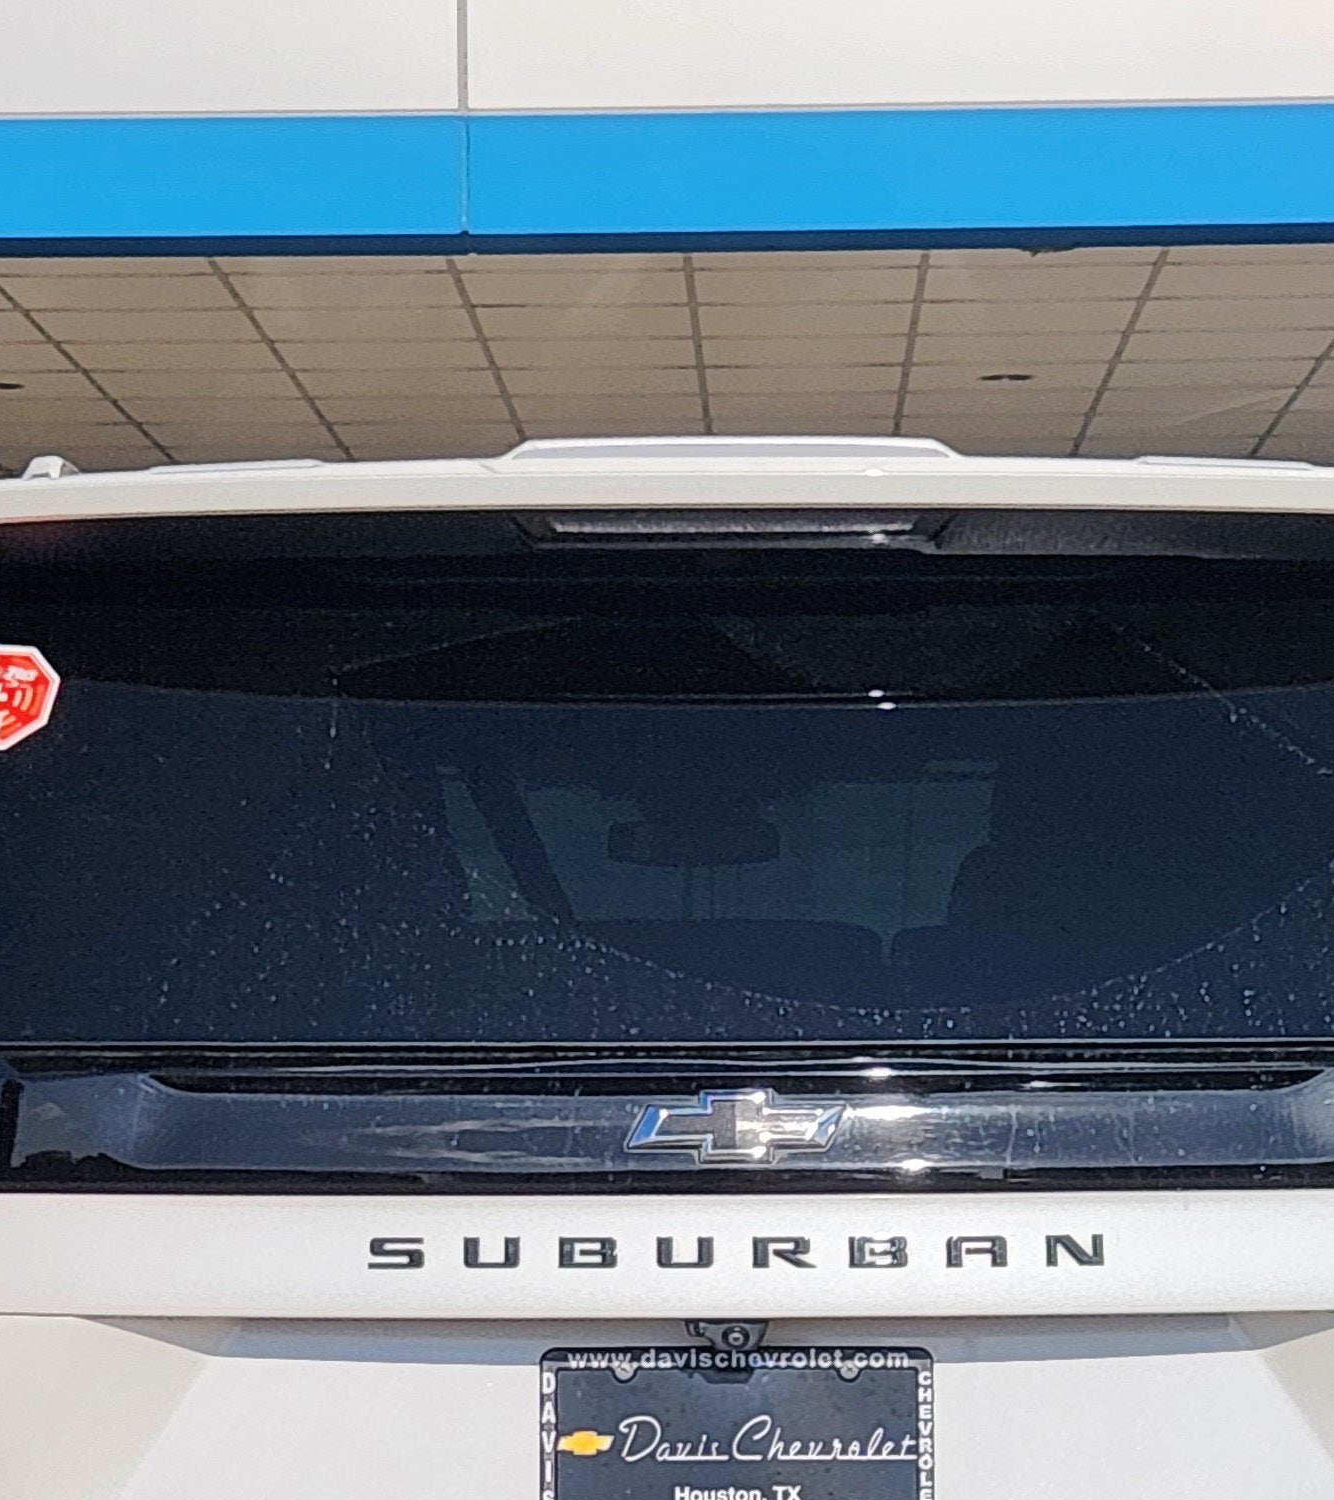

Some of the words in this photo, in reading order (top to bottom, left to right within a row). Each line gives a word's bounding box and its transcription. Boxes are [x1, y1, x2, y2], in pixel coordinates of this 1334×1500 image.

[368, 1234, 1105, 1269] SUBURBAN
[567, 1347, 910, 1369] www.davischevrolet.com
[618, 1415, 729, 1462] Davis
[732, 1414, 918, 1461] Chevrolet
